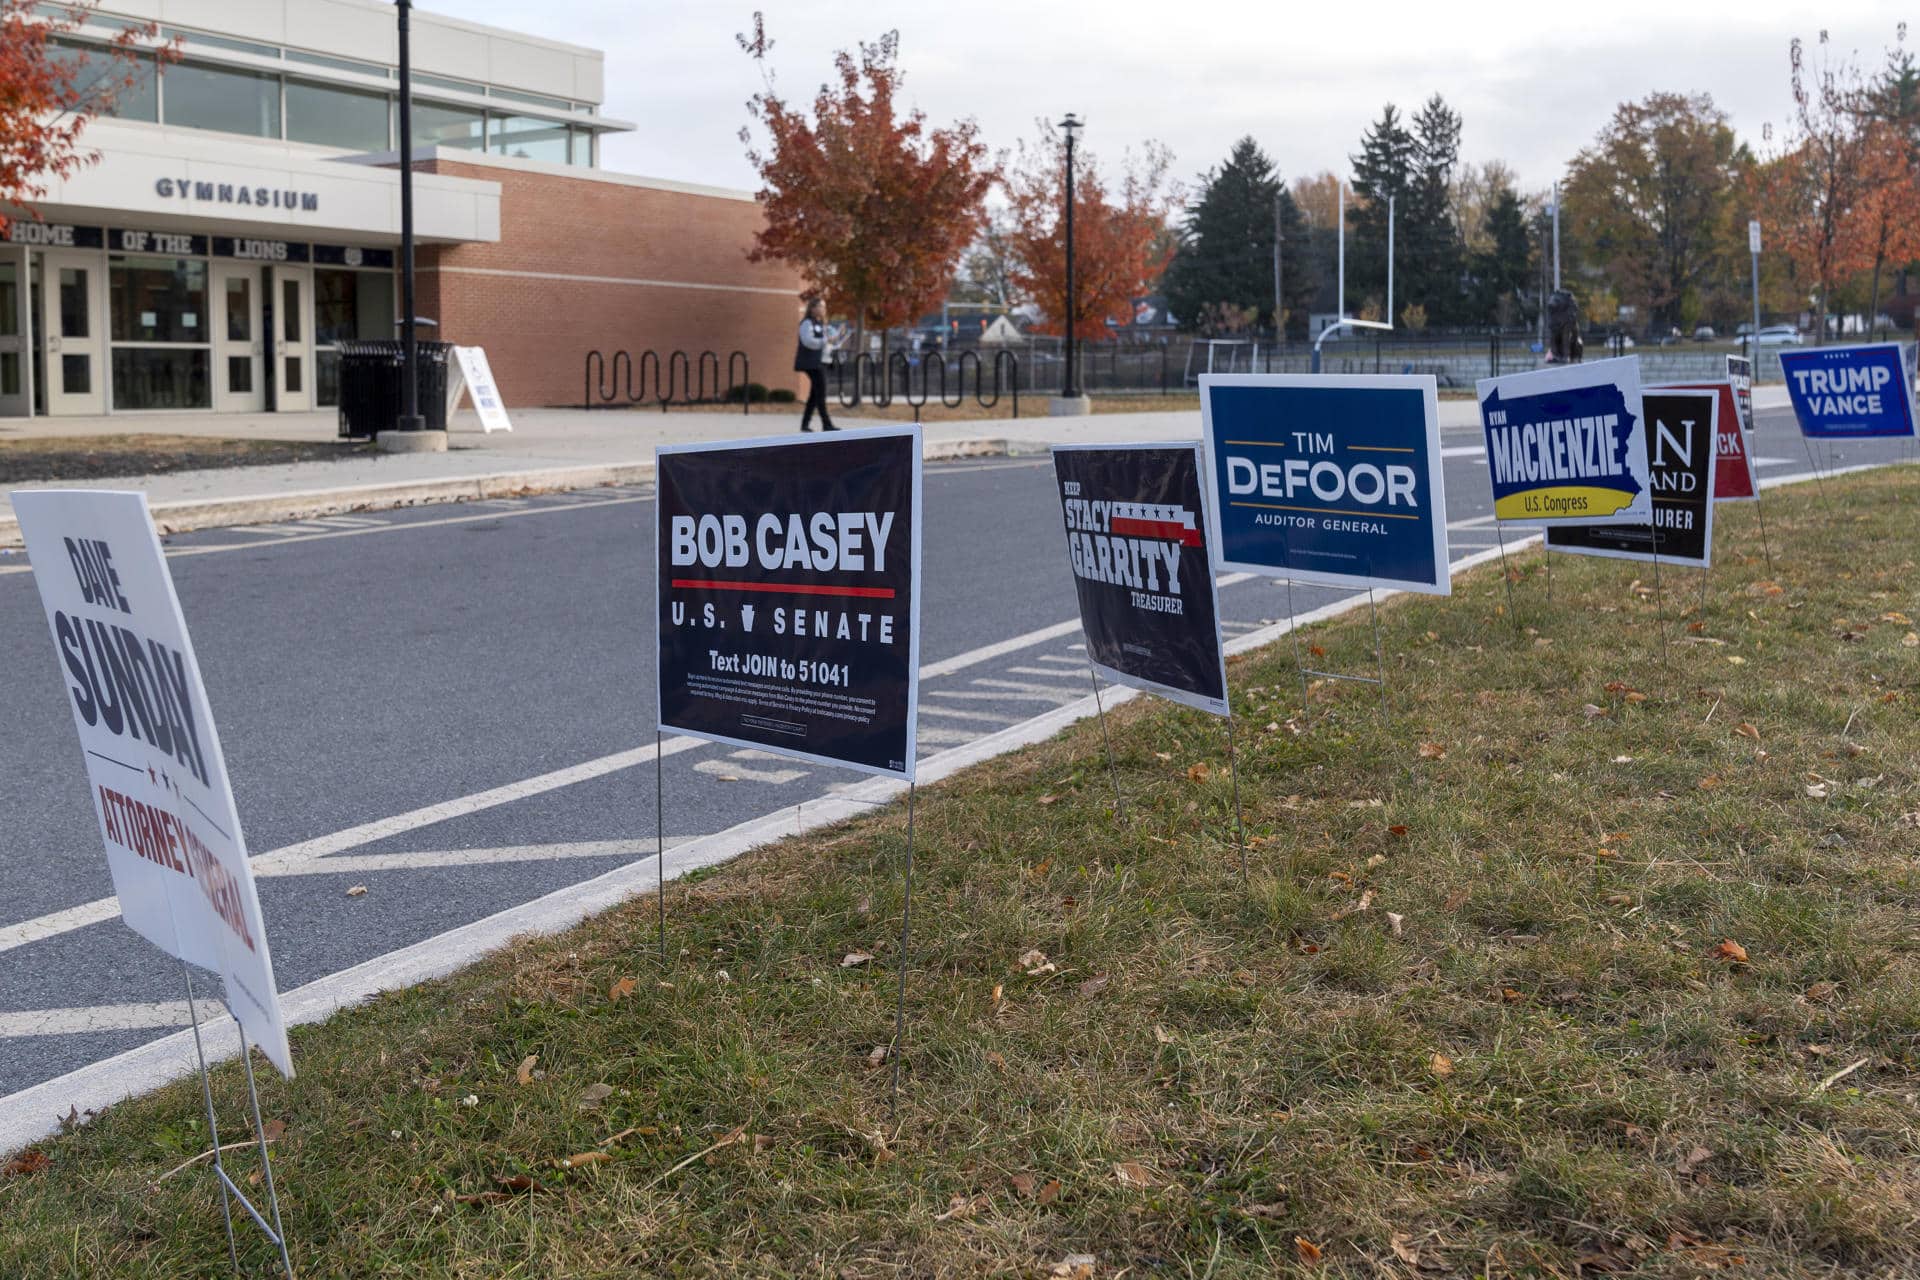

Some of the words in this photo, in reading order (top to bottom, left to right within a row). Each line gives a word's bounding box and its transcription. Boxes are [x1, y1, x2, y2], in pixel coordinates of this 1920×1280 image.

[156, 177, 319, 211] GYMNASIUM
[11, 222, 74, 245] HOME
[122, 230, 149, 250] OF
[152, 232, 192, 254] THE
[233, 238, 288, 261] LIONS
[1793, 366, 1890, 395] TRUMP
[1488, 410, 1507, 426] RYAN
[1807, 395, 1883, 416] VANCE
[1292, 432, 1334, 454] TIM
[1491, 413, 1623, 484] MACKENZIE
[1716, 432, 1741, 455] CK
[1064, 481, 1081, 496] KEEP
[1524, 496, 1542, 512] U.S.
[1543, 496, 1588, 515] Congress
[1064, 498, 1112, 533] STACY
[1255, 514, 1315, 528] AUDITOR
[1322, 519, 1388, 535] GENERAL
[1655, 508, 1693, 530] URER
[671, 513, 749, 568] BOB
[756, 511, 895, 572] CASEY
[64, 536, 132, 614] DAVE
[1069, 531, 1184, 594] GARRITY
[1131, 591, 1183, 615] TREASURER
[672, 601, 725, 629] U.S.
[774, 607, 894, 644] SENATE
[709, 650, 739, 673] Text
[742, 652, 777, 678] JOIN
[780, 659, 796, 681] to
[799, 660, 849, 687] 51041
[55, 609, 210, 788] SUNDAY
[99, 784, 194, 878] ATTORNEY
